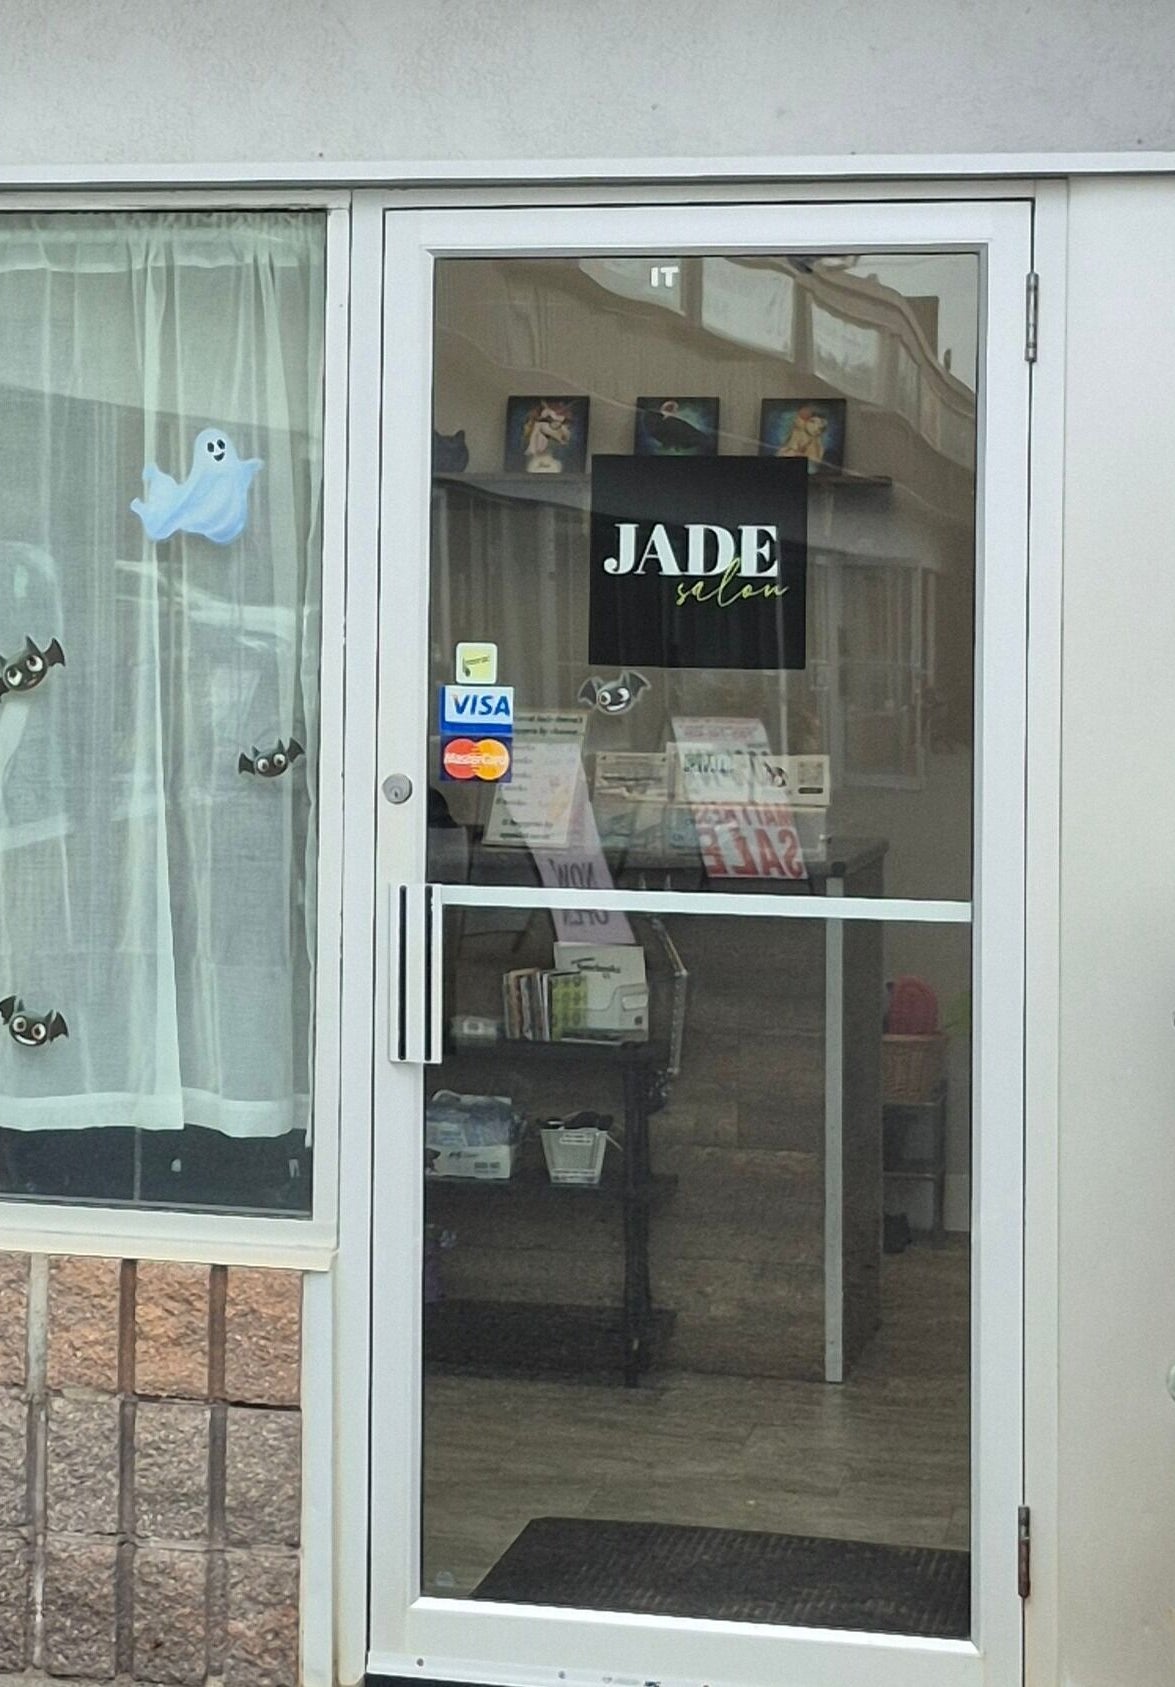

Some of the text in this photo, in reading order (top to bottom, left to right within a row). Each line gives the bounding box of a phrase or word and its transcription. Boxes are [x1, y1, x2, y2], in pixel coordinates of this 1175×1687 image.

[651, 266, 679, 288] IT
[603, 523, 779, 577] JADE
[675, 557, 791, 608] salon
[453, 694, 510, 717] VISA
